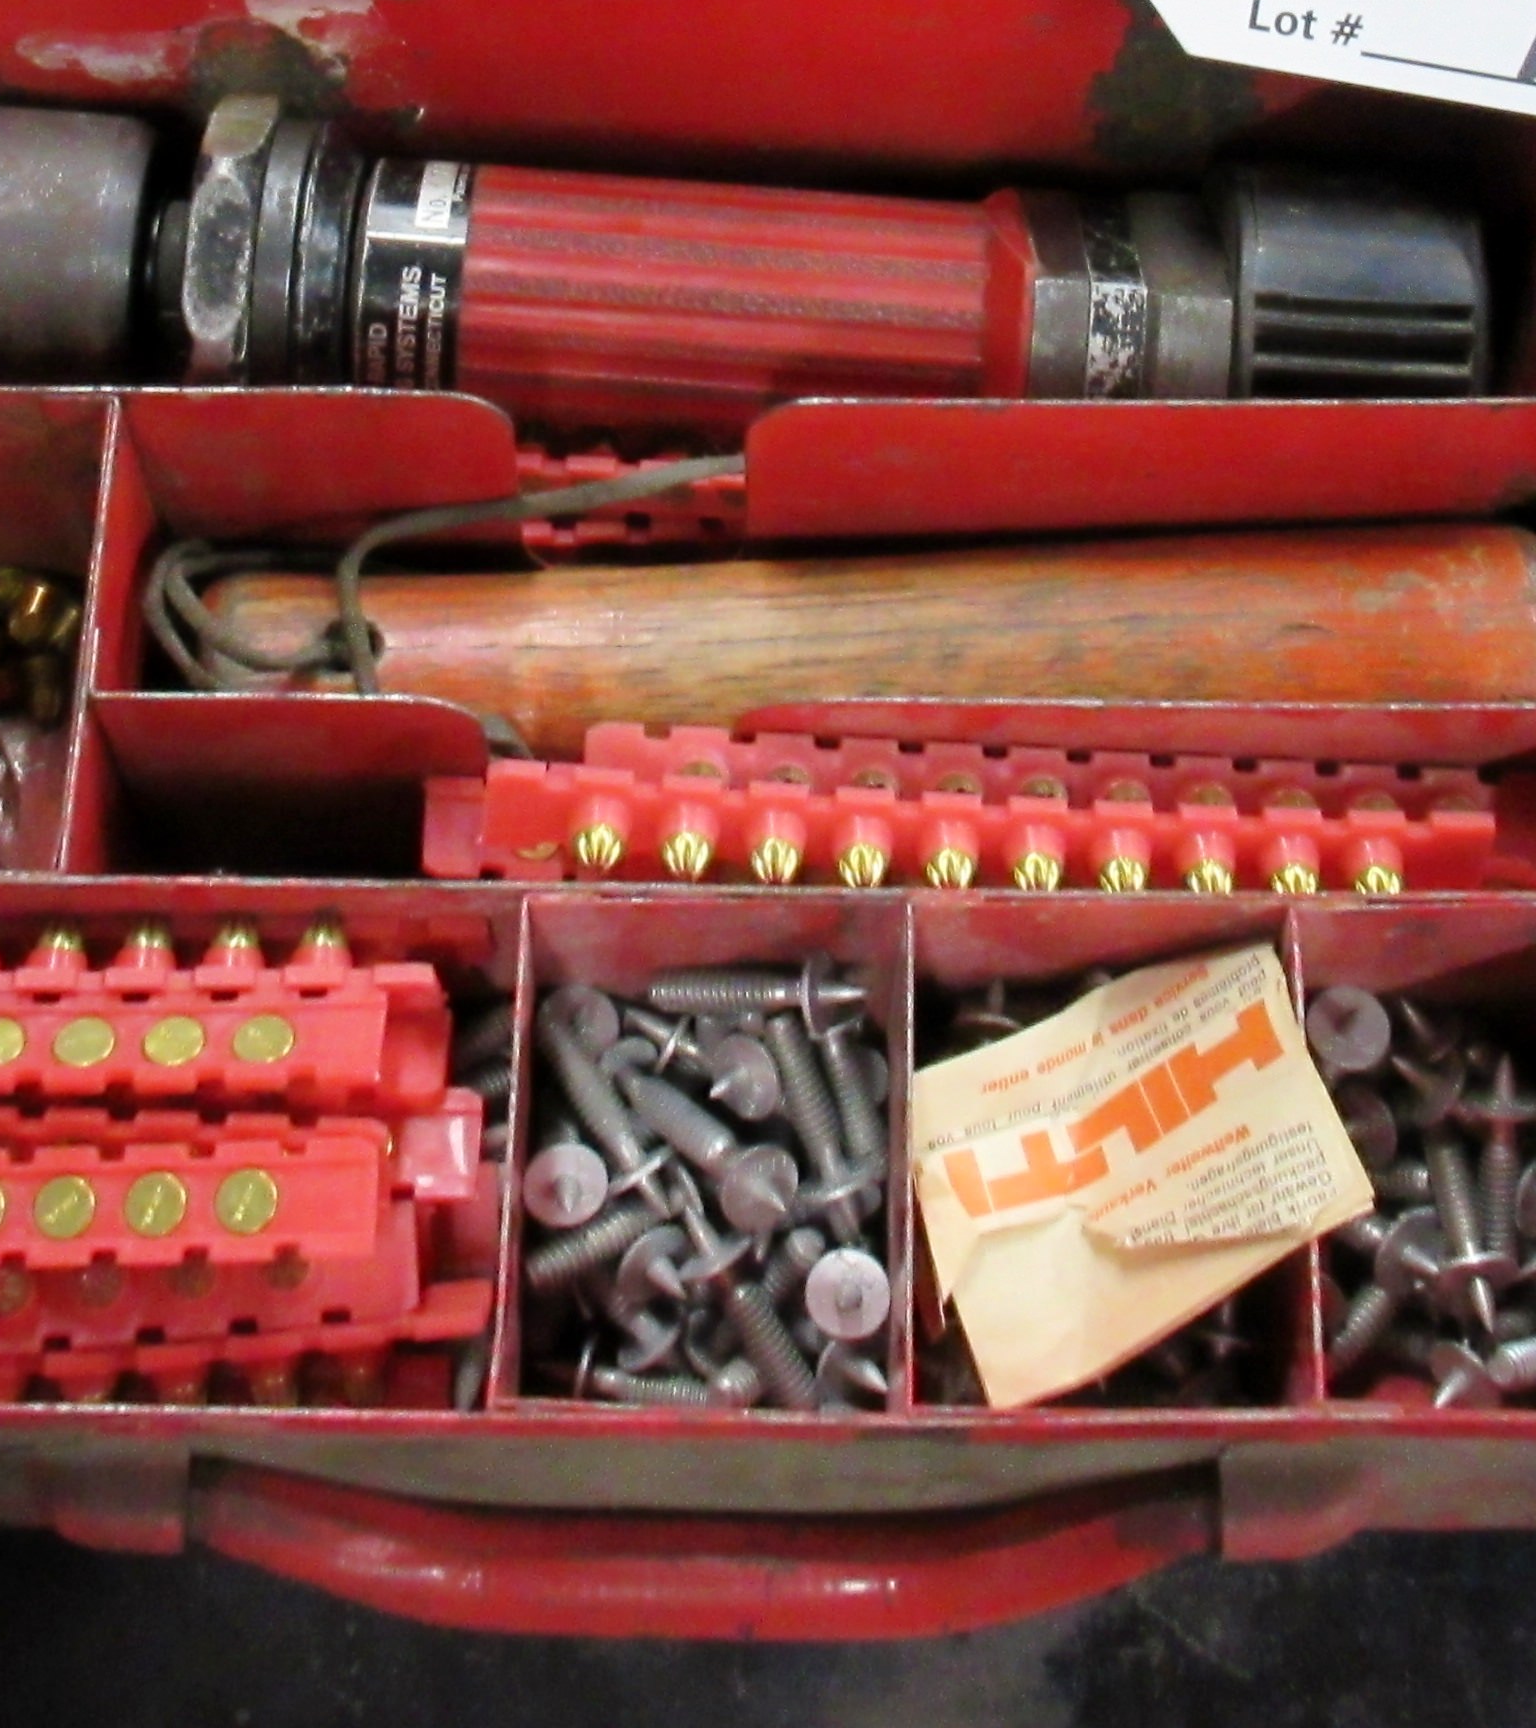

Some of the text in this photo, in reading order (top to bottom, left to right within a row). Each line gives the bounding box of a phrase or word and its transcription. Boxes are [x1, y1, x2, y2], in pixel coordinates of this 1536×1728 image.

[1330, 12, 1365, 47] #
[396, 265, 422, 374] SYSTEMS
[1108, 1005, 1148, 1036] dans
[1171, 1006, 1190, 1025] de
[1198, 996, 1231, 1024] vous
[1034, 1039, 1090, 1078] monde
[978, 1068, 1031, 1098] entier
[943, 998, 1284, 1219] HILTI
[1006, 1100, 1043, 1122] pour
[1163, 1122, 1252, 1180] Weltweiter
[1181, 1161, 1268, 1213] technischer
